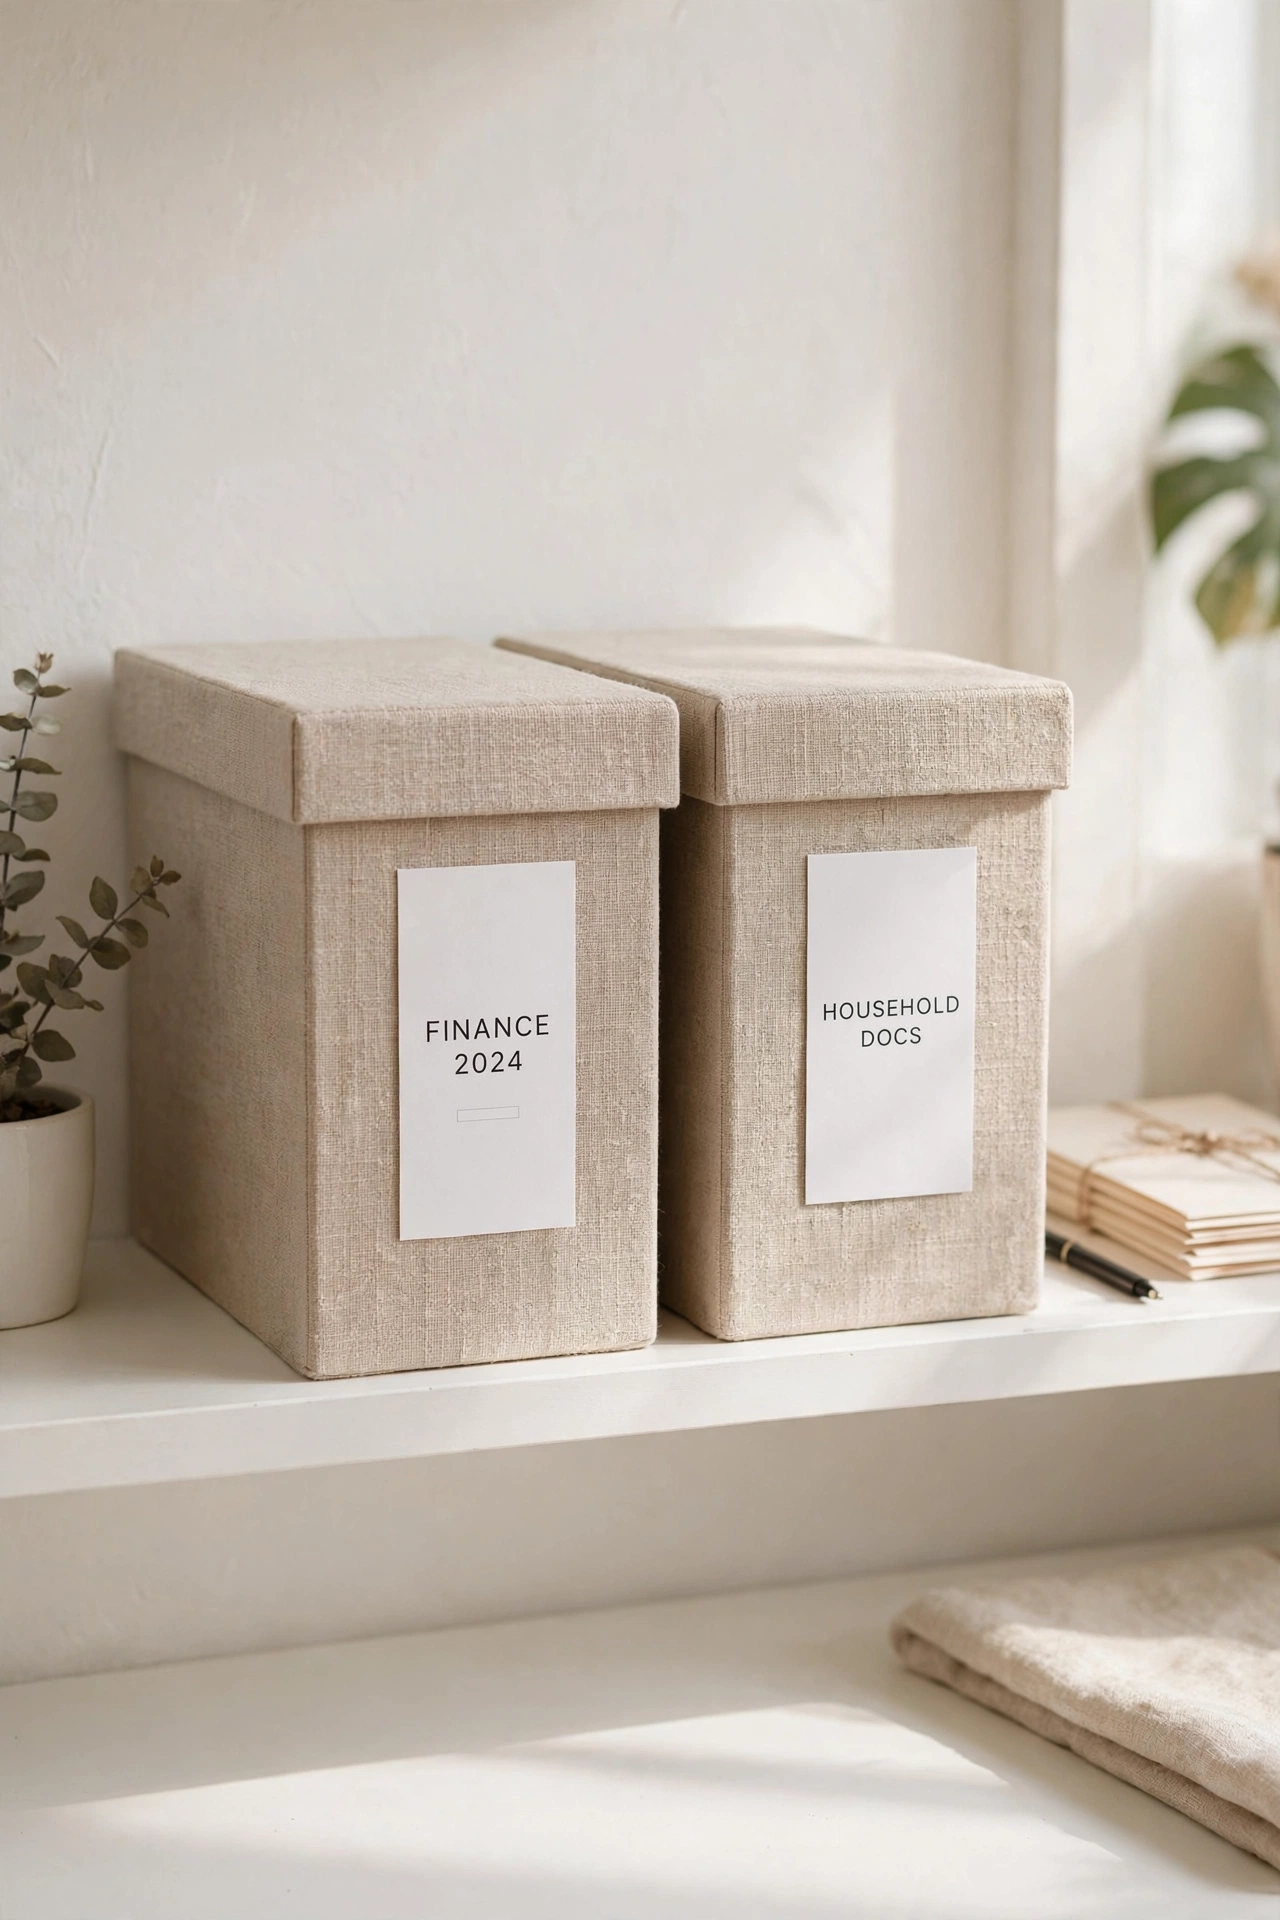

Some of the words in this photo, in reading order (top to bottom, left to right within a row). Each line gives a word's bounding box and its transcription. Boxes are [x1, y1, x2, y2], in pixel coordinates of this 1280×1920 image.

[823, 995, 959, 1021] HOUSEHOLD
[426, 1014, 549, 1043] FINANCE
[861, 1026, 921, 1047] DOCS
[455, 1050, 523, 1075] 2024
